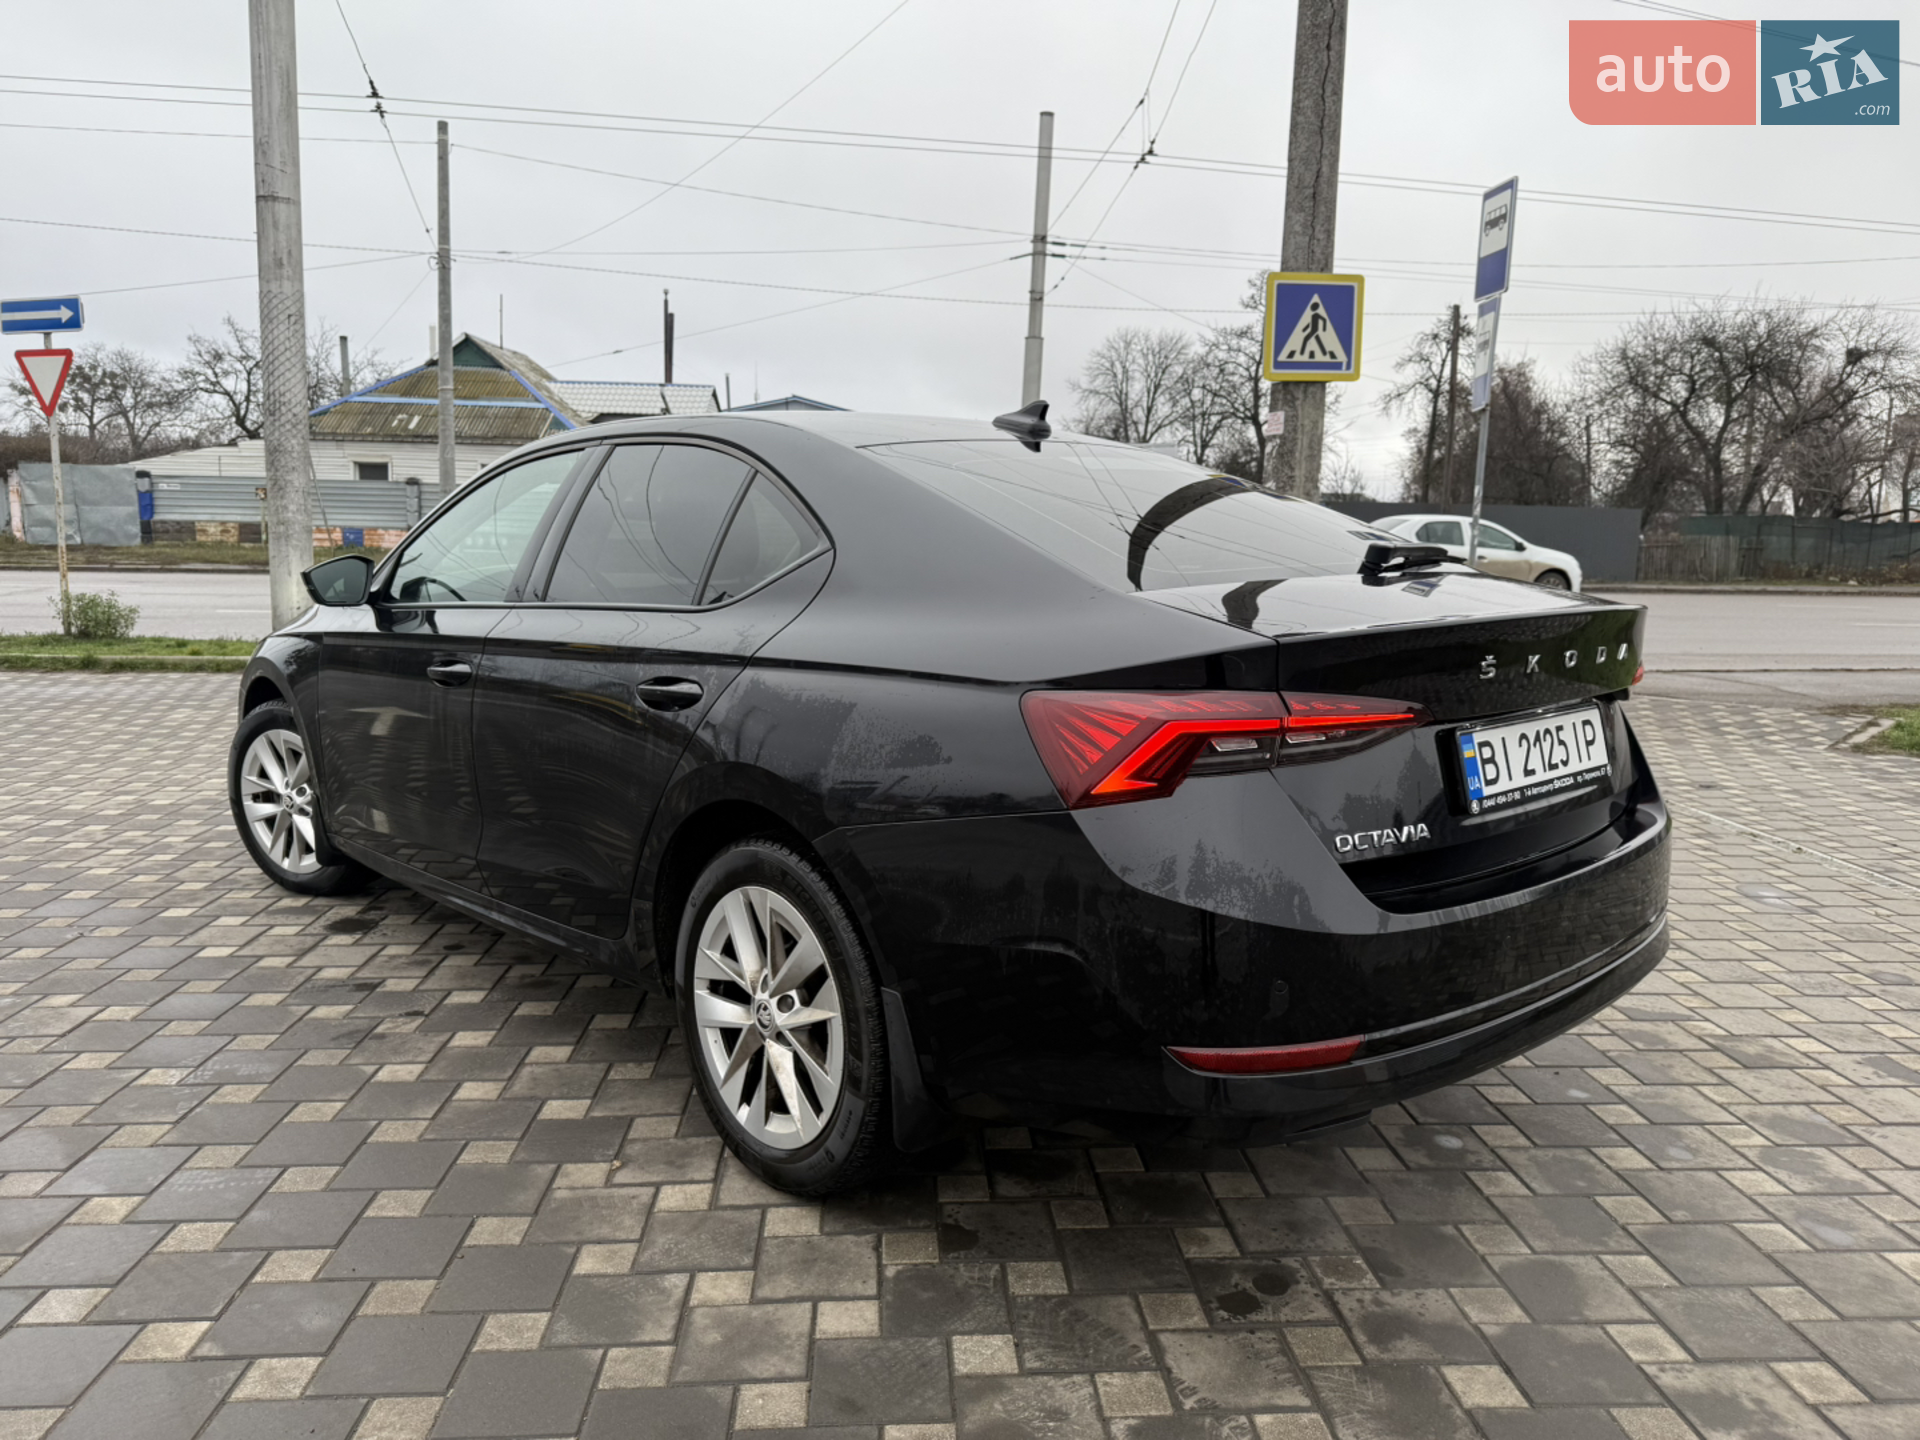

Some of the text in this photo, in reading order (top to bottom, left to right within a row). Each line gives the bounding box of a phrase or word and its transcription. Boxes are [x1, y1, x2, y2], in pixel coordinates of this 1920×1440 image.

[1480, 643, 1628, 679] ŠKODA
[1477, 719, 1596, 787] BI 2125 IP
[1468, 776, 1481, 790] UA
[1554, 776, 1574, 789] ŠKODA
[1335, 823, 1431, 852] OCTAVIA
